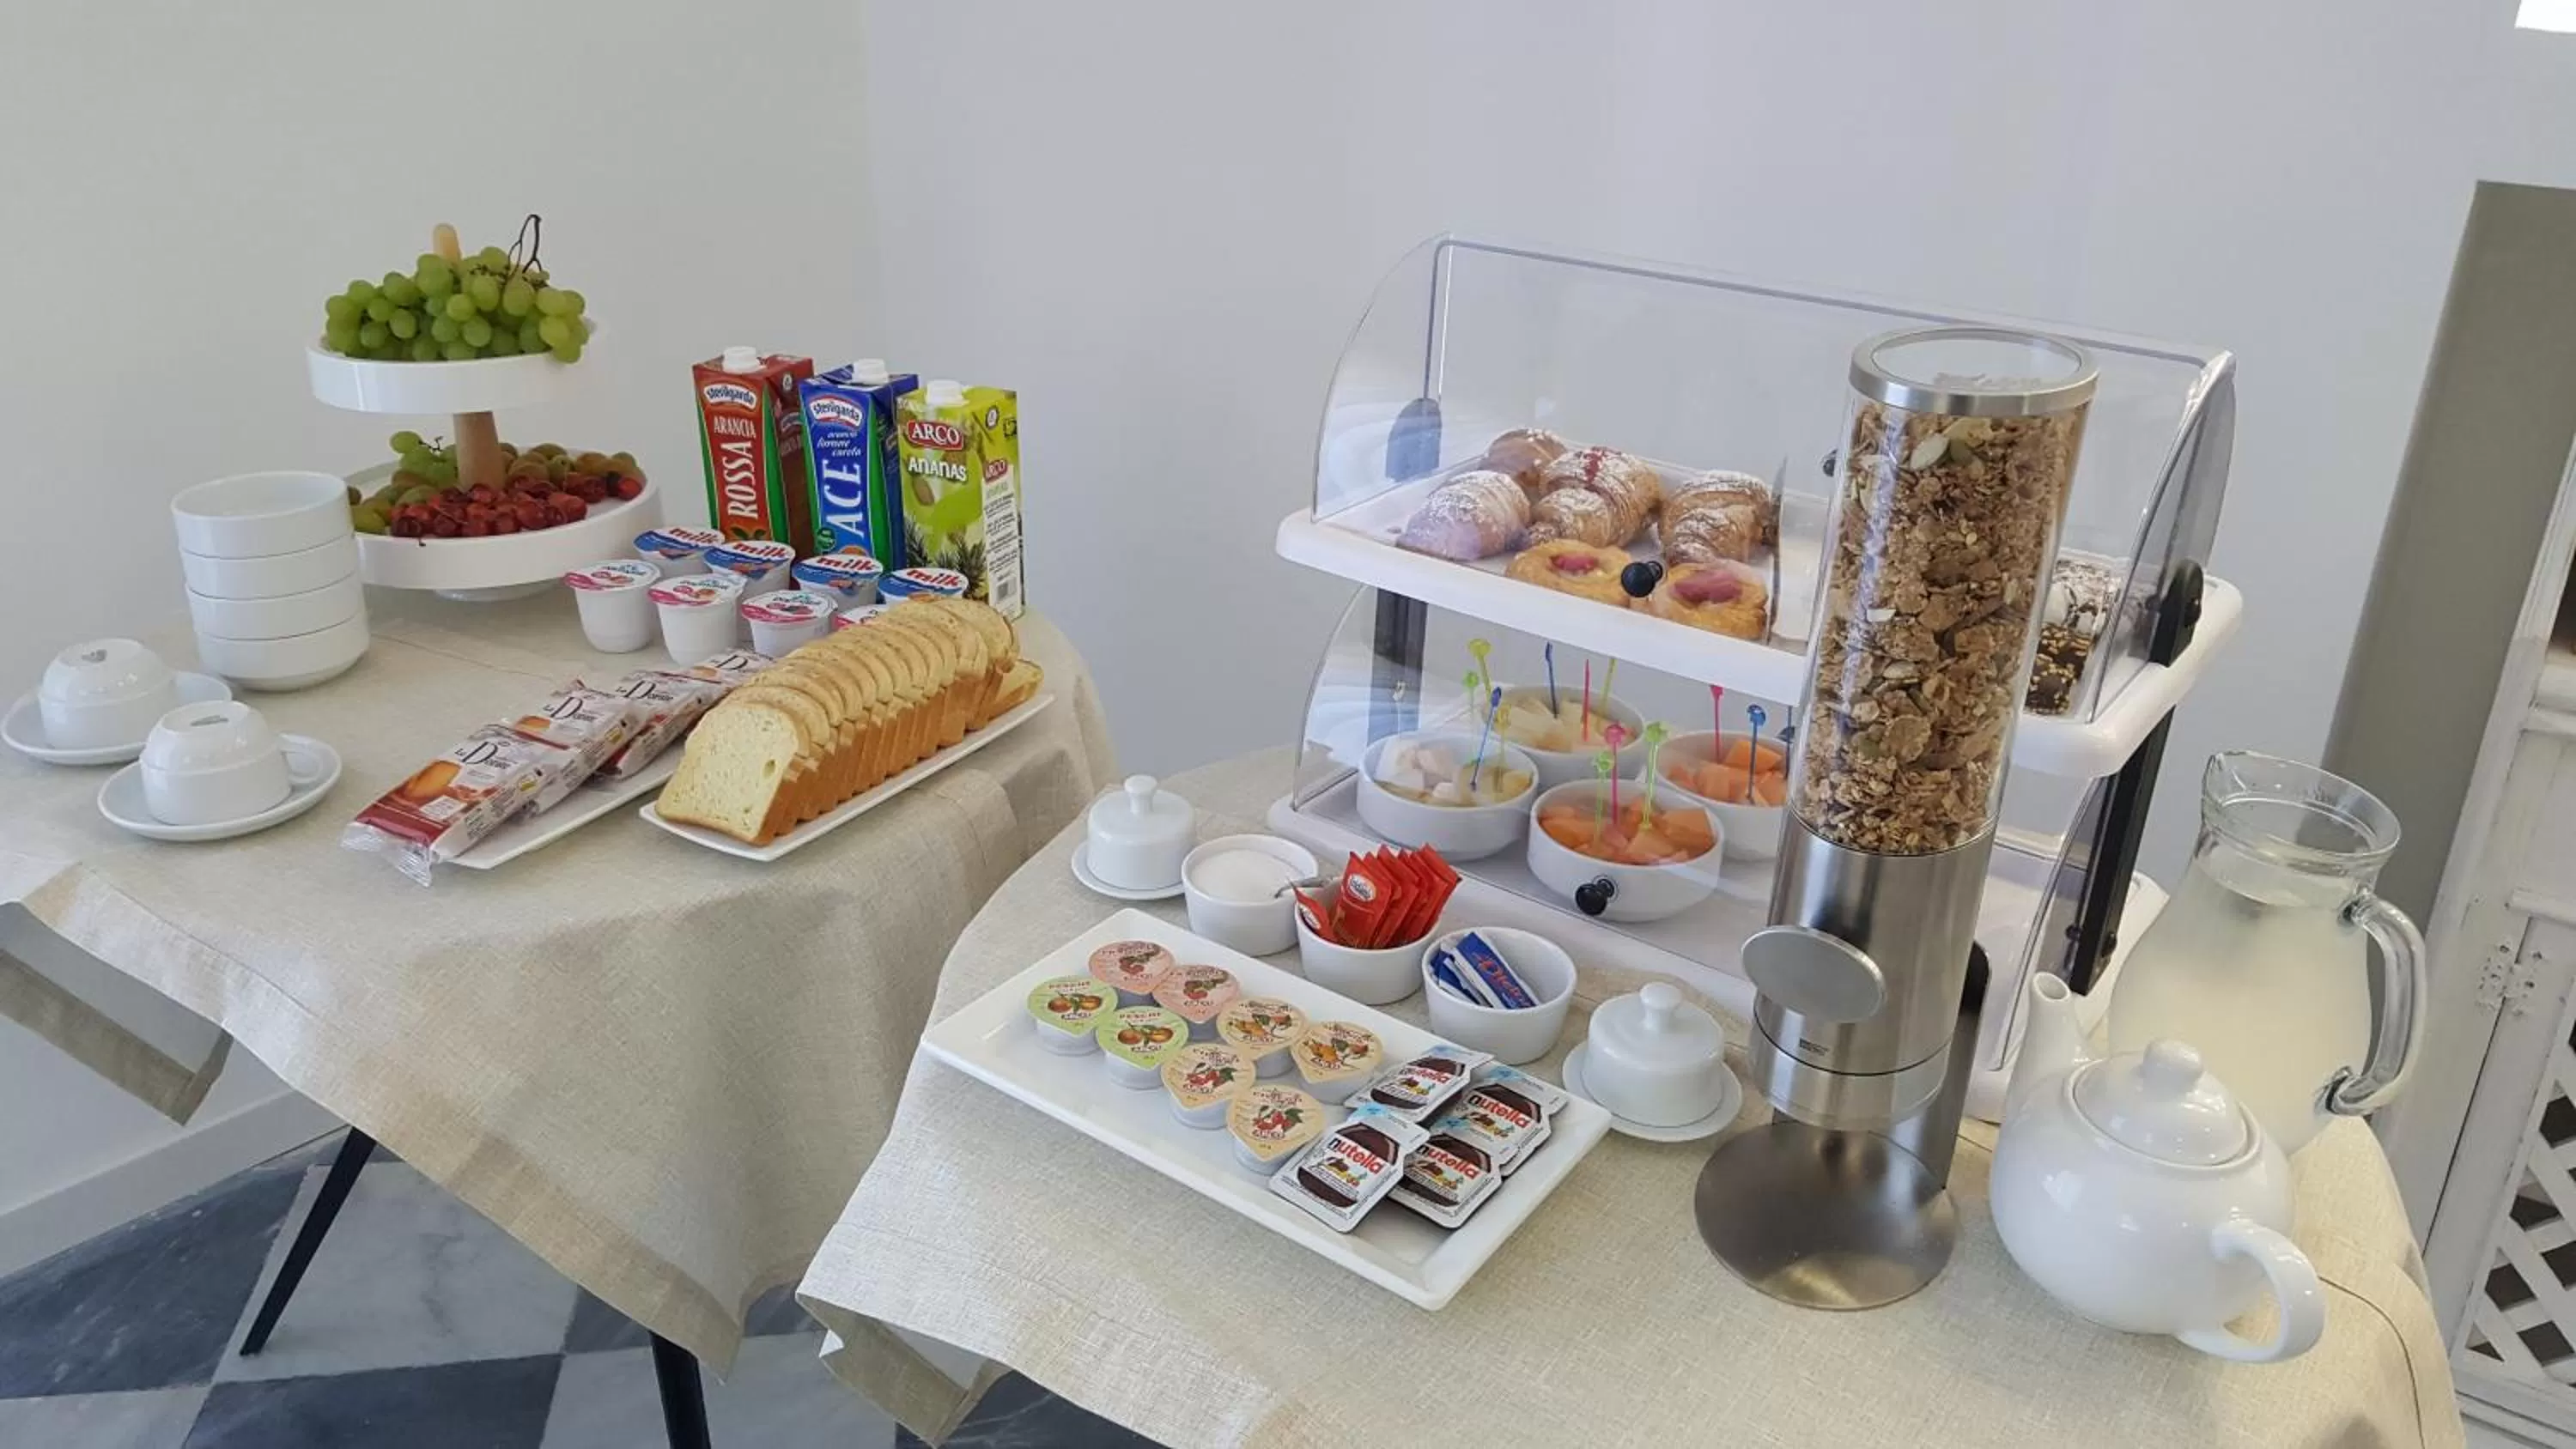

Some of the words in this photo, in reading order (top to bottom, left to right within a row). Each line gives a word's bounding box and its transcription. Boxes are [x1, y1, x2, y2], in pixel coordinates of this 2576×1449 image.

[714, 415, 756, 439] ARANCIA
[912, 423, 959, 446] ARCO
[720, 441, 759, 520] ROSSA
[822, 458, 865, 539] ACE
[668, 526, 719, 544] milk
[732, 542, 787, 558] milk
[817, 556, 876, 572] milk
[906, 568, 962, 586] milk
[1467, 1094, 1529, 1129] nutella
[1327, 1137, 1385, 1176] nutella
[1418, 1143, 1479, 1180] nutella
